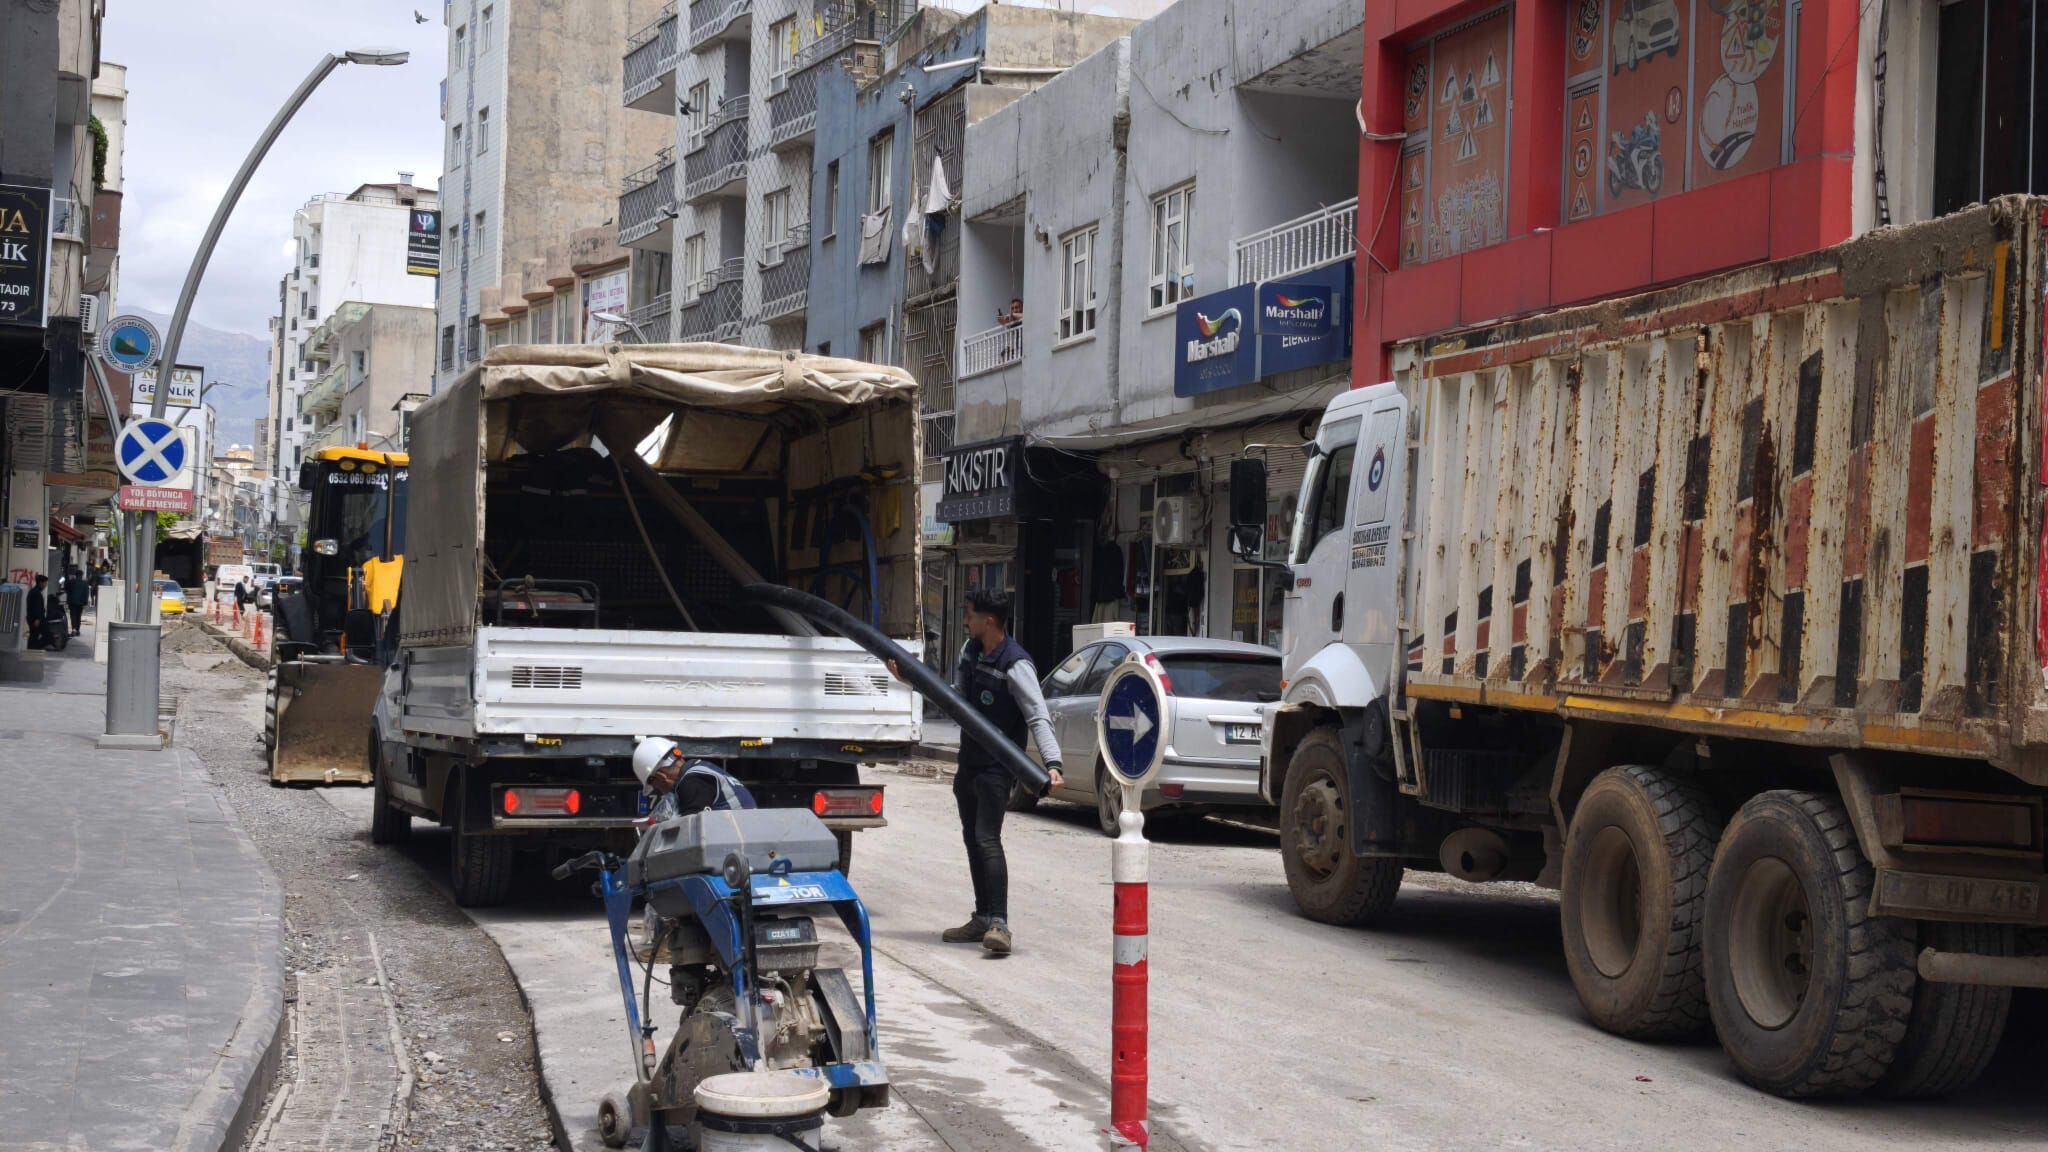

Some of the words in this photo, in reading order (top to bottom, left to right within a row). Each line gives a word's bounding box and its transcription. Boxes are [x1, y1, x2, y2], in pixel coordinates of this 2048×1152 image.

[0, 238, 29, 262] İK
[1265, 305, 1318, 320] Marshall
[1187, 331, 1239, 362] Marshall
[941, 447, 1007, 495] TAKISTIR
[1234, 726, 1246, 738] 12
